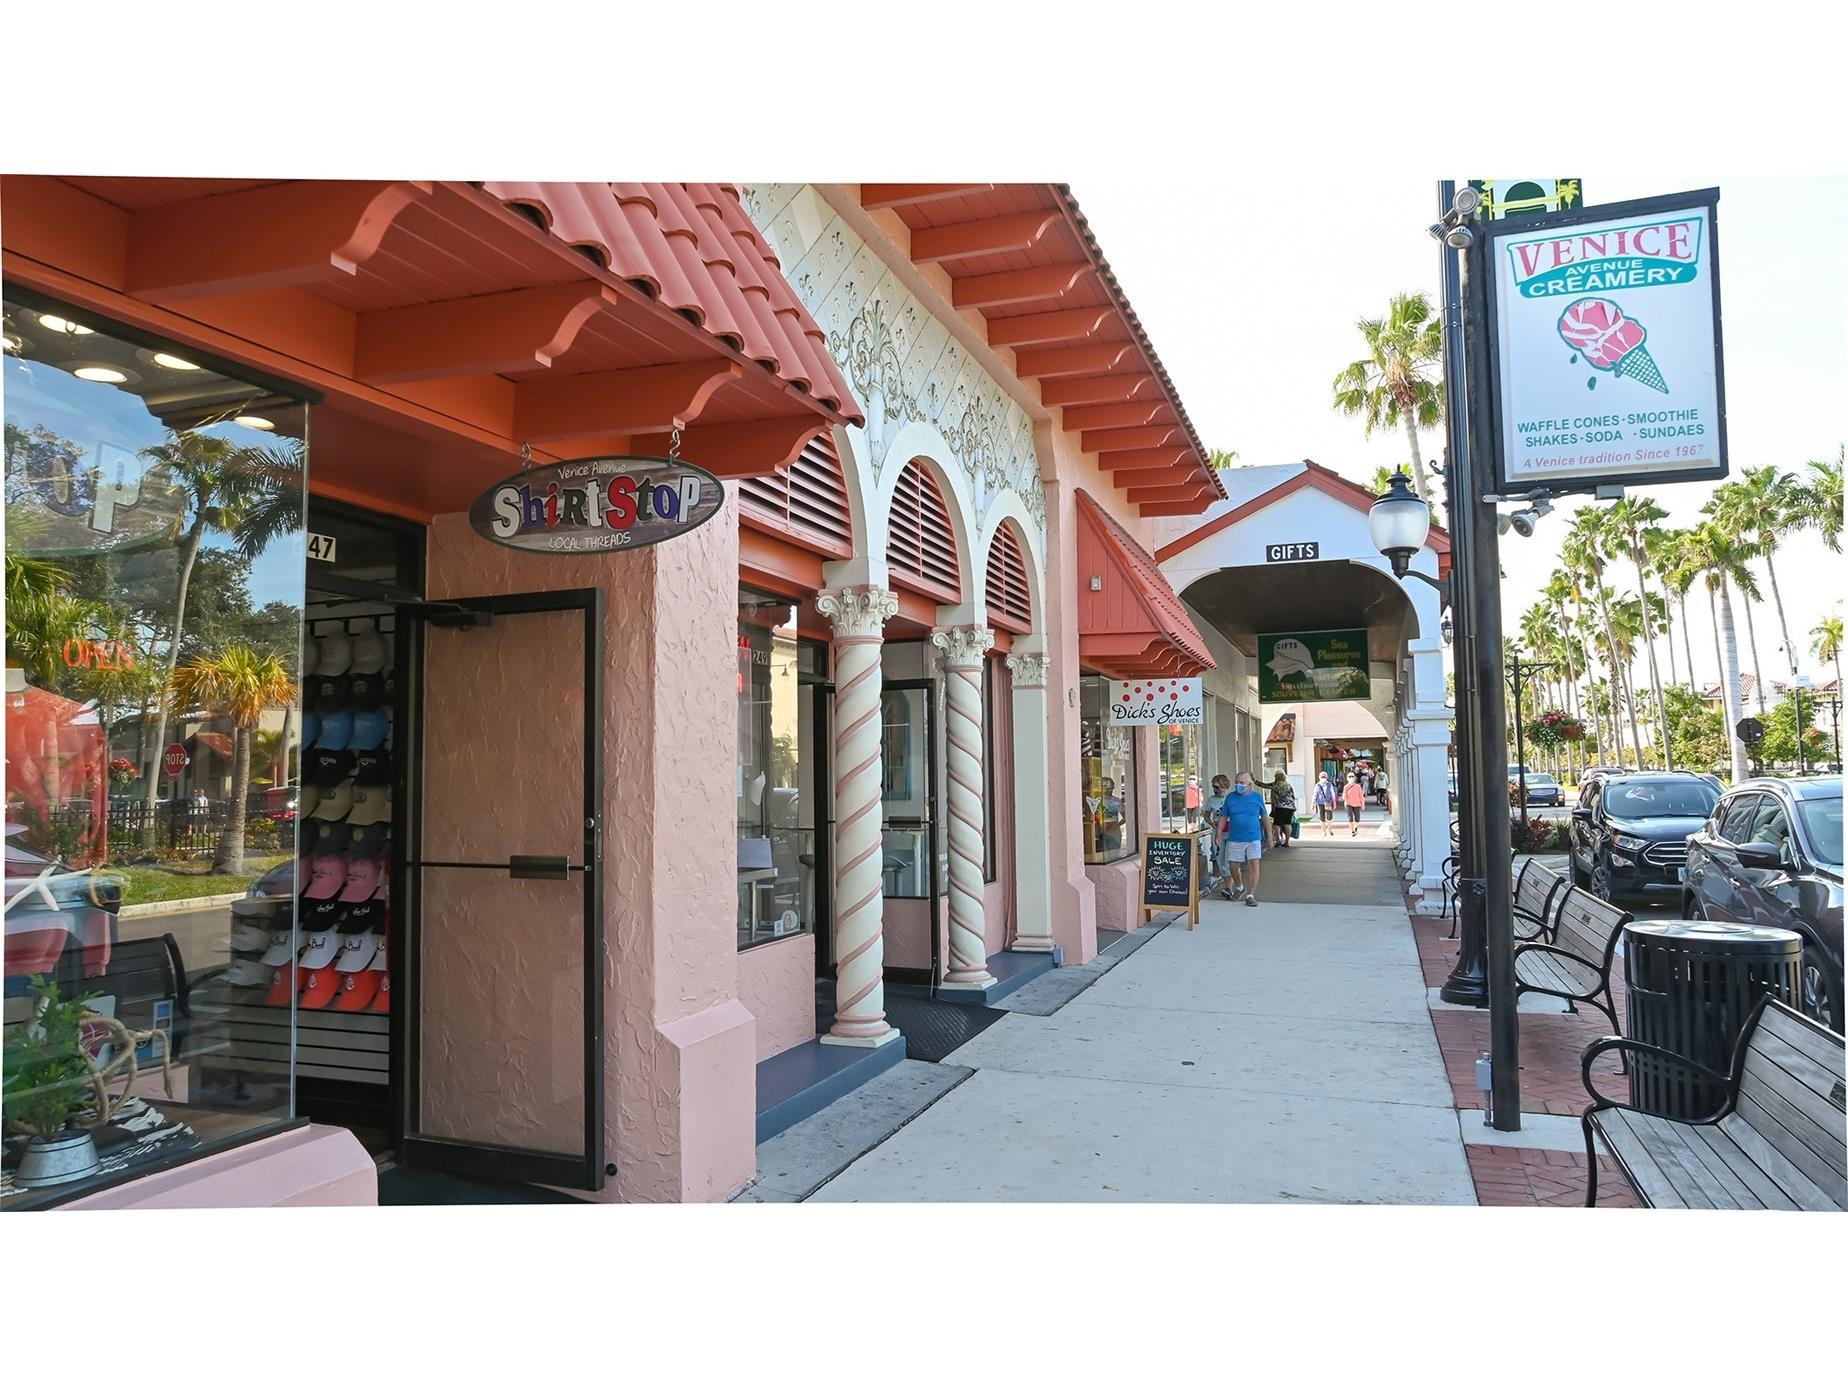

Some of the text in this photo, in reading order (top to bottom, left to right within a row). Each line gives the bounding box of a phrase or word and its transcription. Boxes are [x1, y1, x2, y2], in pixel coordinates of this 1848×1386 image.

[1516, 223, 1692, 277] VENICE
[1565, 259, 1644, 277] AVENUE
[1528, 267, 1683, 296] CREAMERY
[1517, 409, 1699, 433] WAFFLE CONES SMOOTHIE
[1525, 424, 1705, 447] SHAKES SODA SUNDAES
[1523, 444, 1705, 468] A Venice tradition Since 1967
[557, 461, 628, 479] Venice Avenue
[549, 532, 632, 550] LOCAL THREADS
[1271, 544, 1314, 560] GIFTS
[1275, 642, 1298, 650] GIFTS
[1112, 701, 1201, 724] Dick's Shoes
[1153, 841, 1183, 850] HUGE
[1154, 856, 1182, 865] SALE
